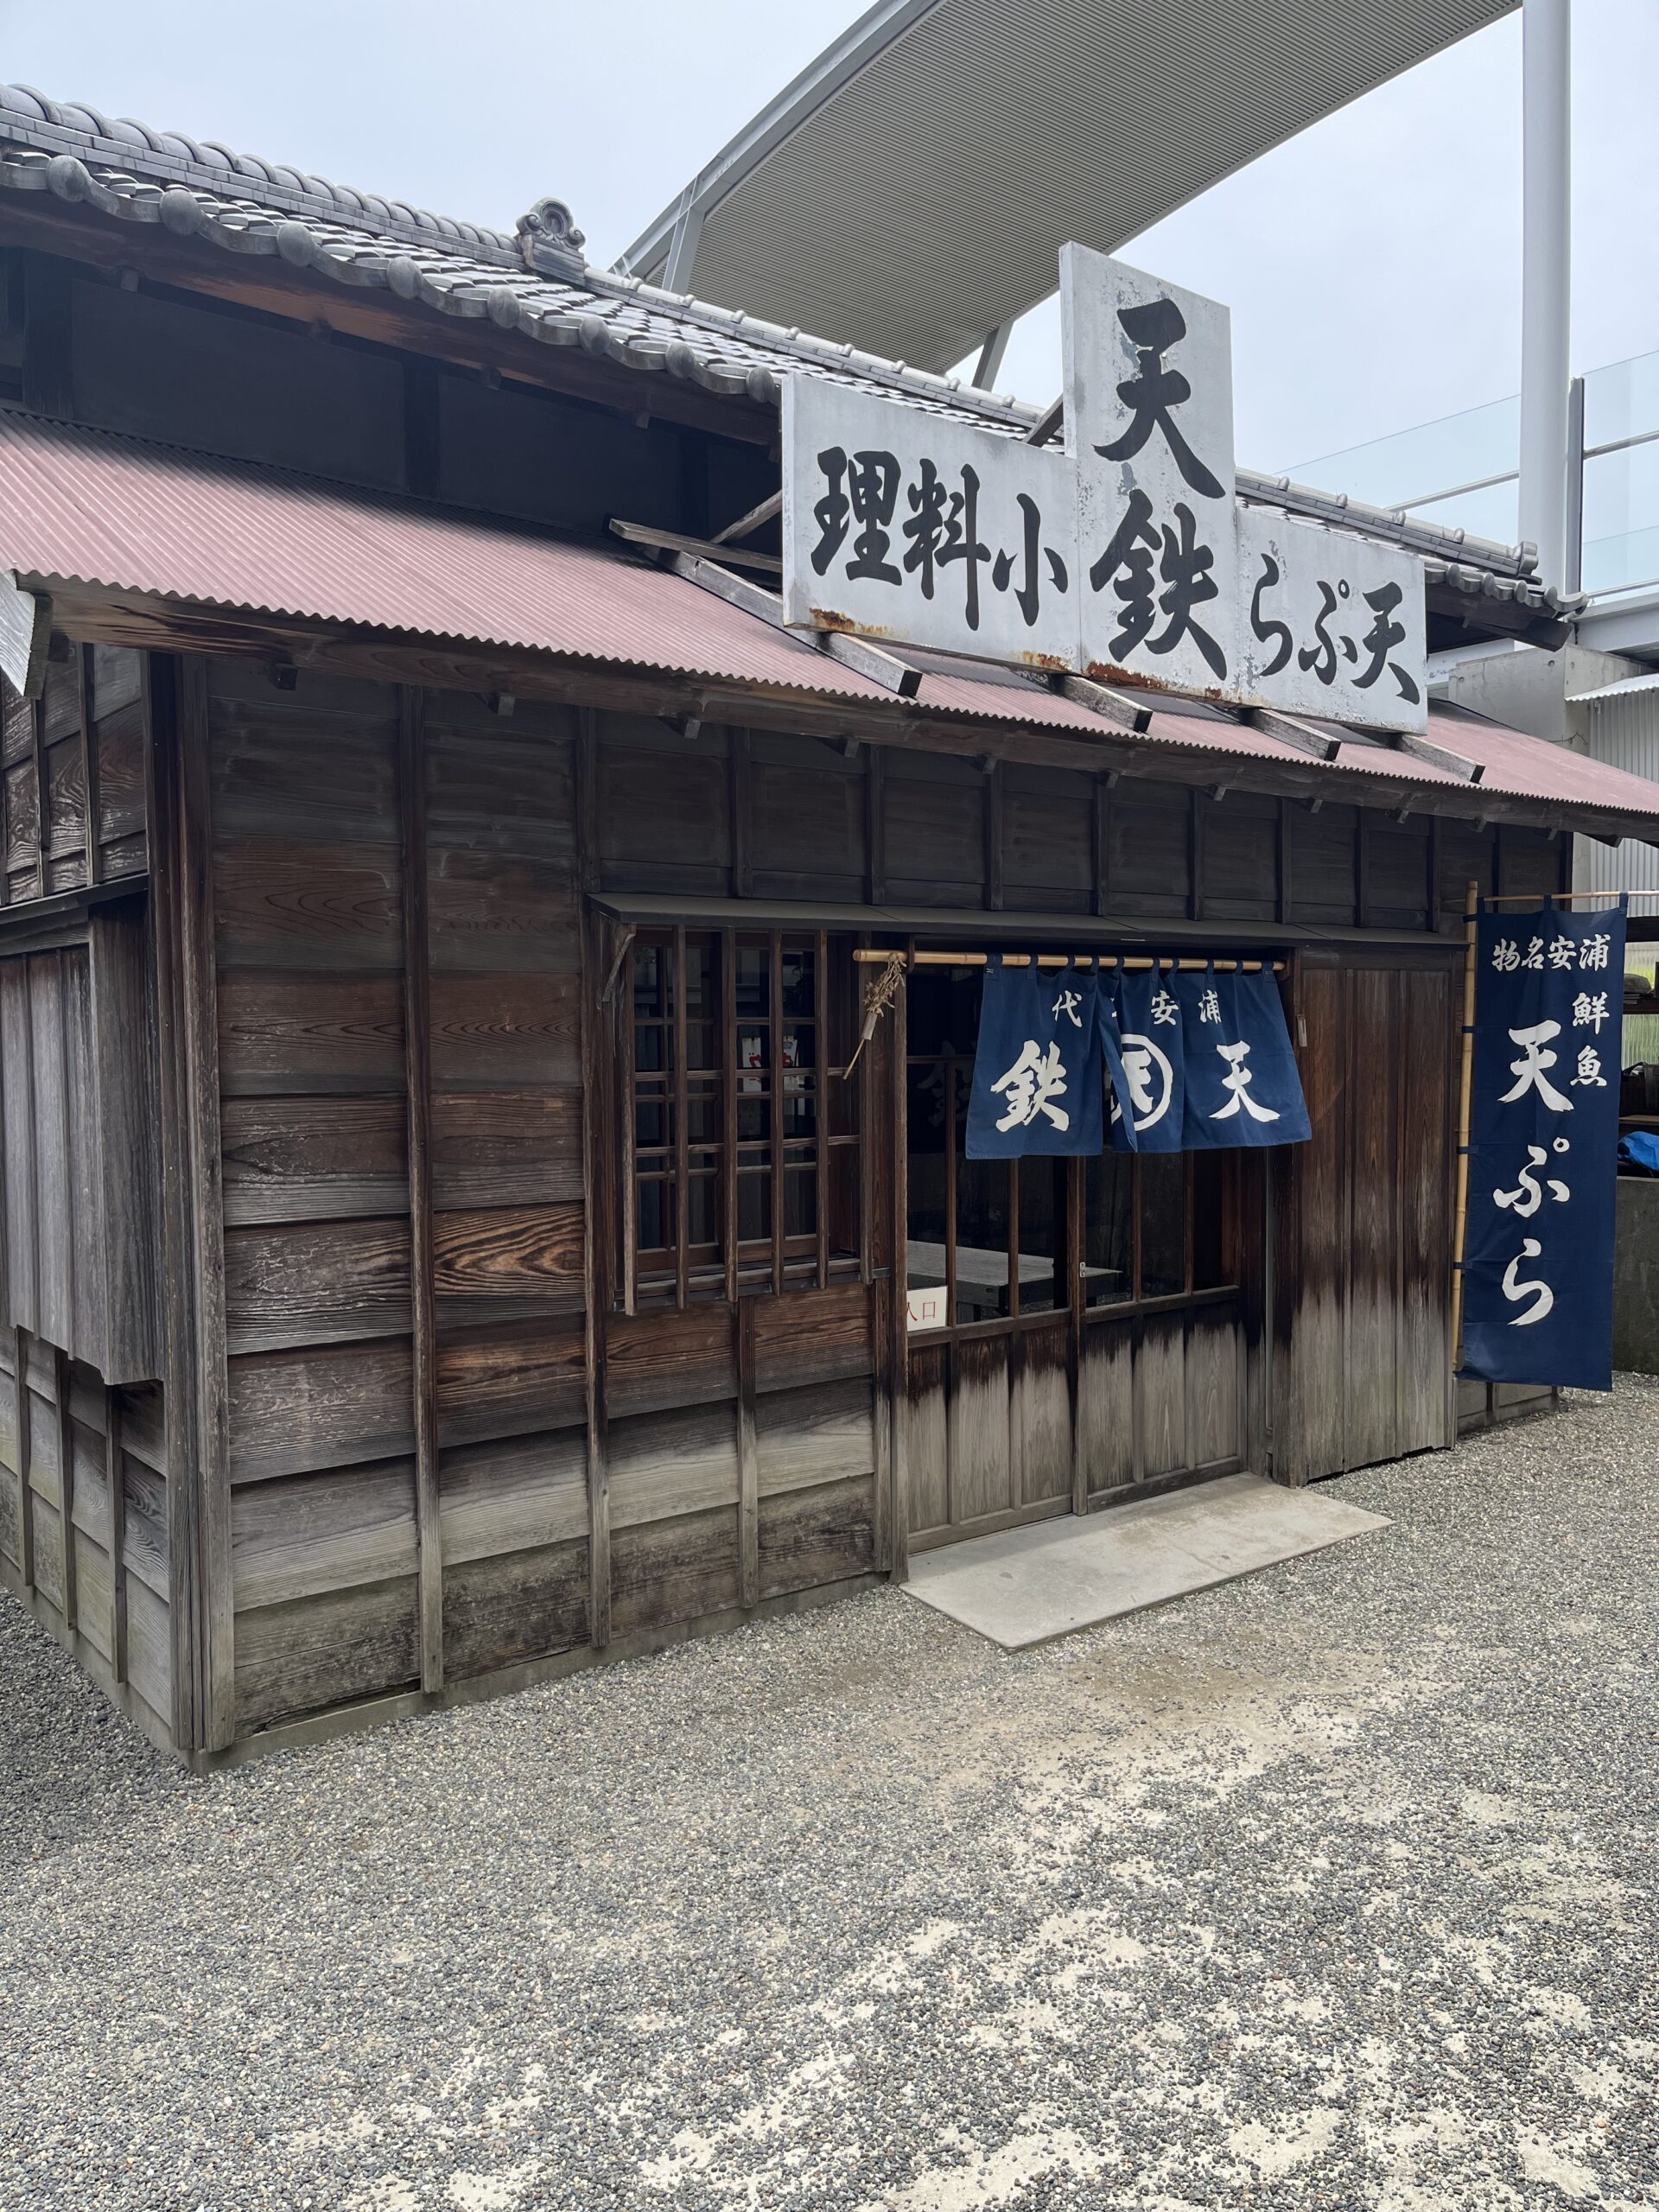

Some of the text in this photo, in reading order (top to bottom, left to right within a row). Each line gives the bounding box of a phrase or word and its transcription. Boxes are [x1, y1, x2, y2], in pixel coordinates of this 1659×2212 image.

[1090, 298, 1228, 681] 天鉄
[1492, 1020, 1574, 1326] 天ぷら
[1569, 991, 1610, 1087] 鮮魚
